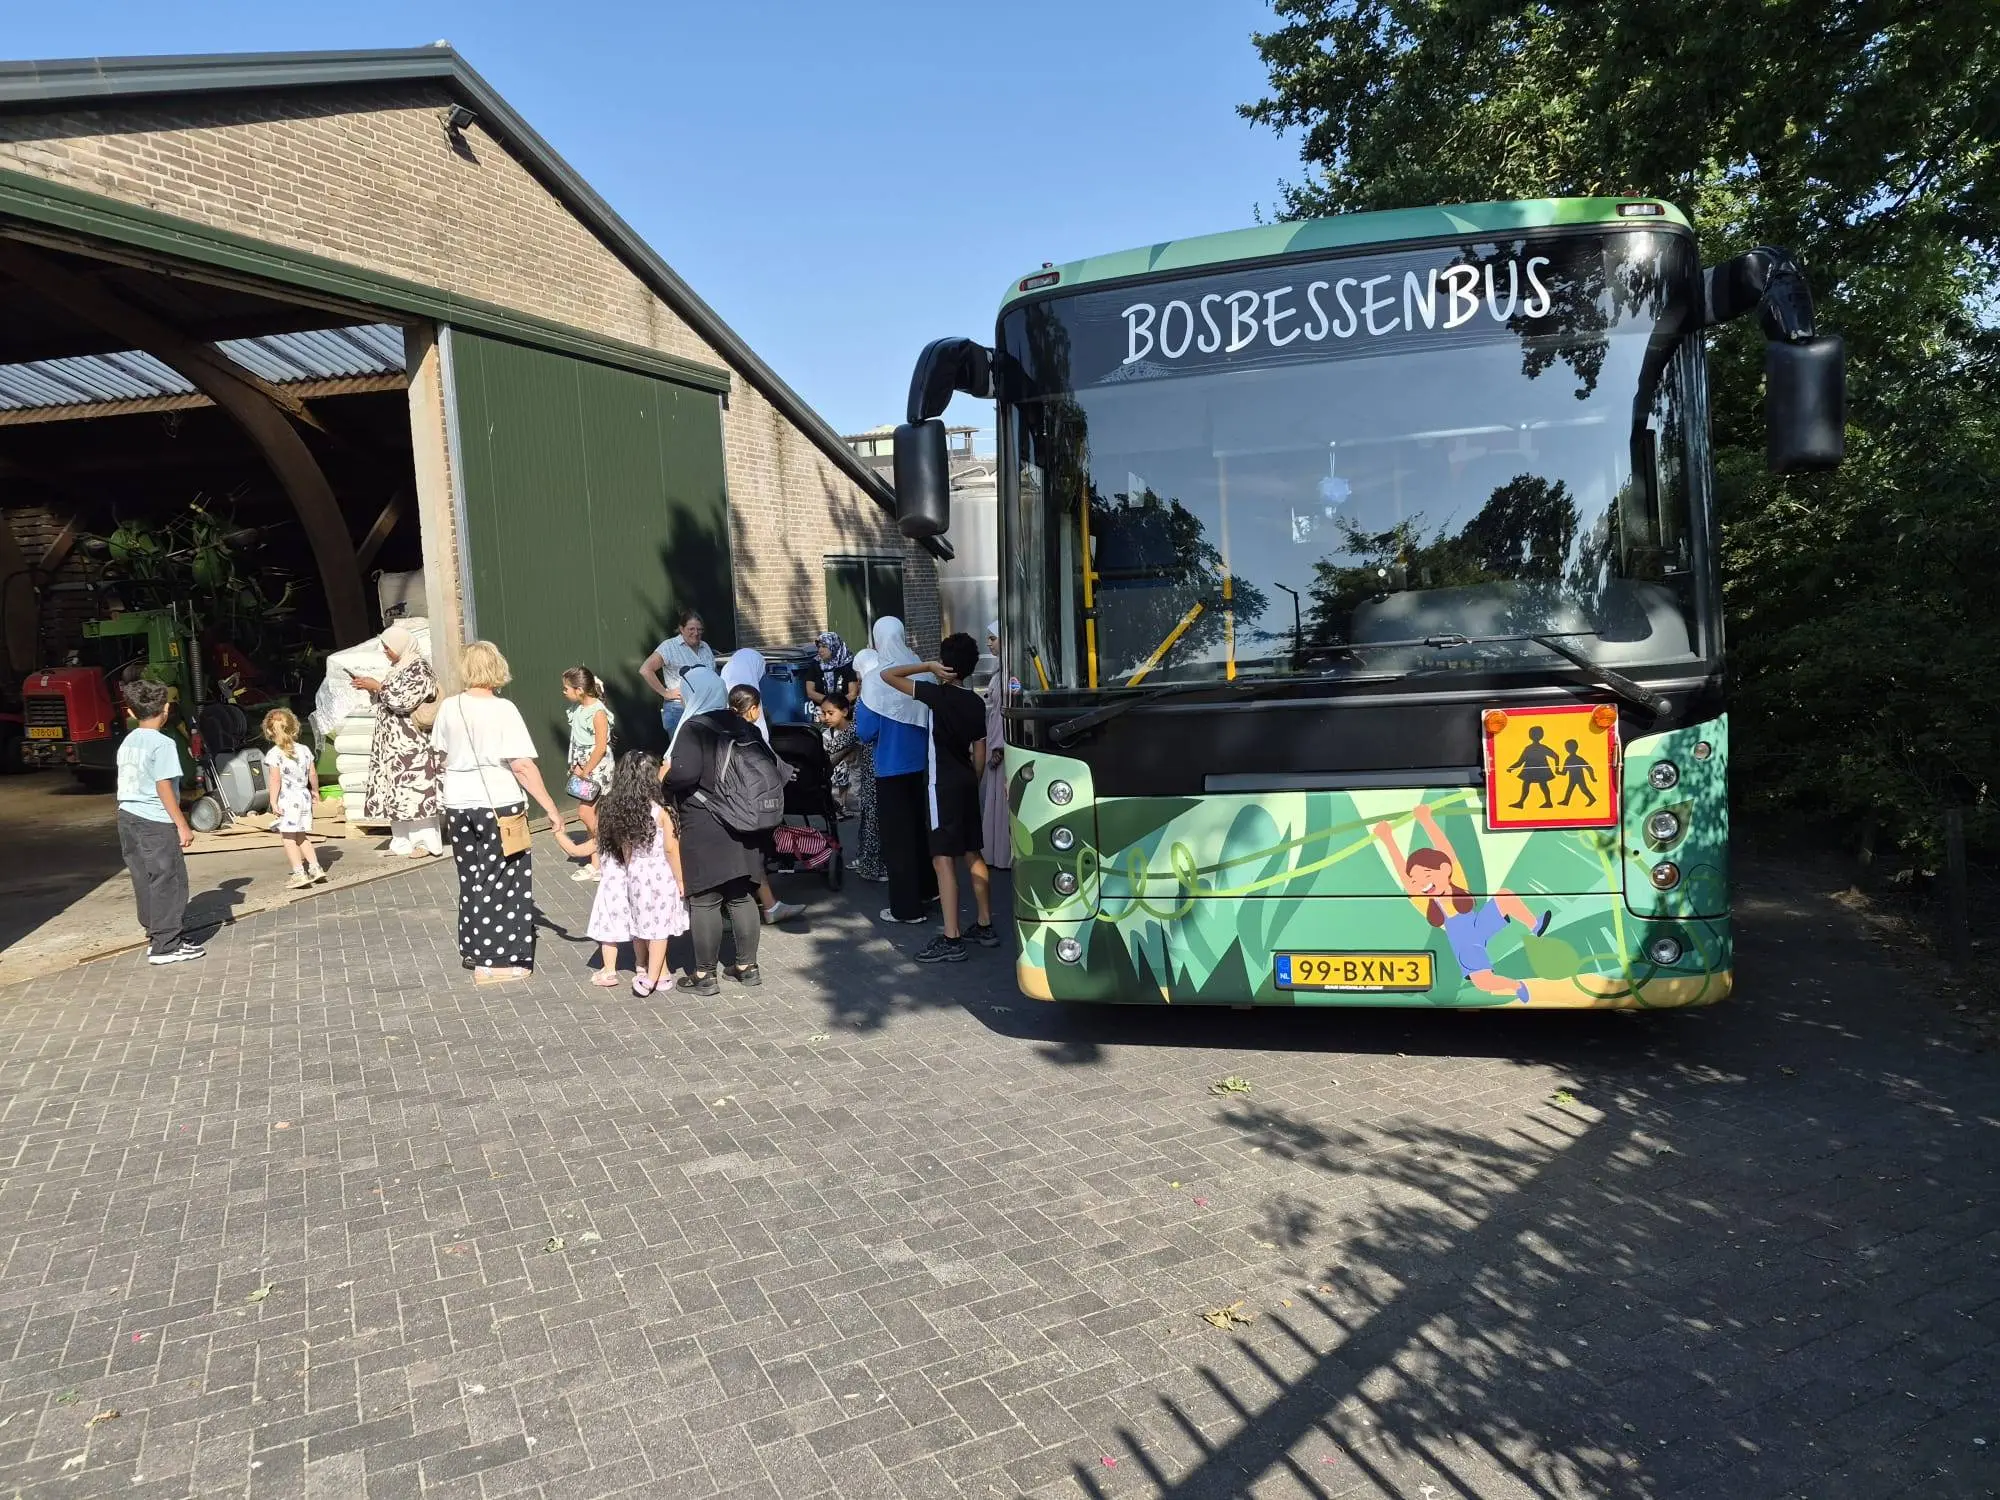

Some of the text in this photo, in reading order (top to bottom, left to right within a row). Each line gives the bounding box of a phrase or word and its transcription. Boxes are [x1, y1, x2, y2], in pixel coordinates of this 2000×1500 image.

[1122, 256, 1551, 365] BOSBESSENBUS
[1279, 972, 1290, 980] NL
[1299, 960, 1420, 982] 99-BXN-3
